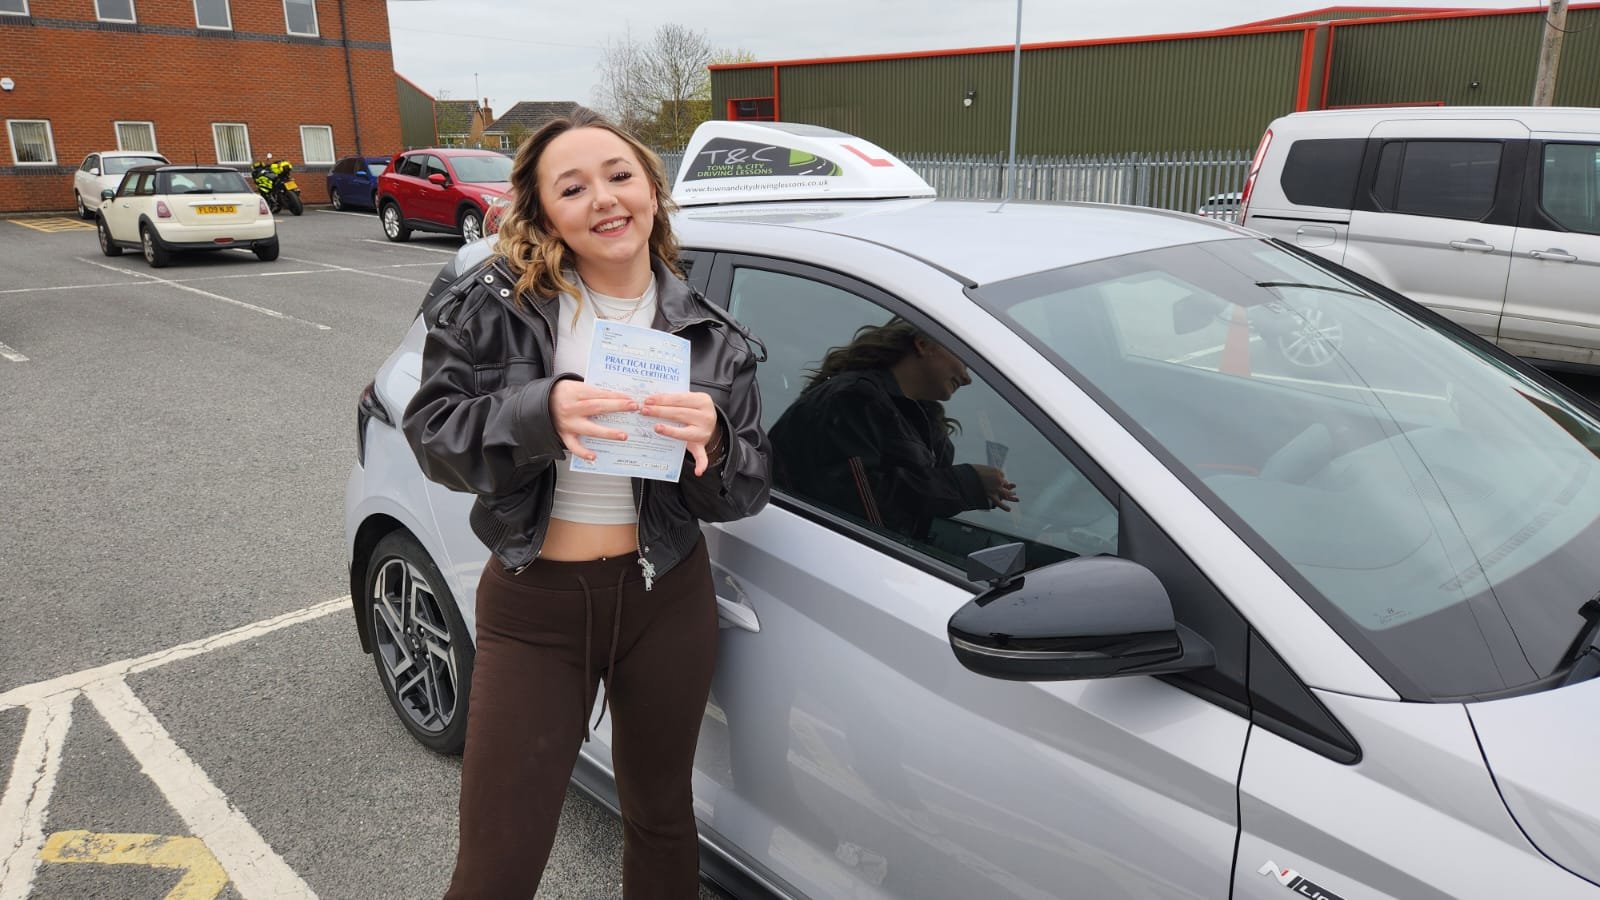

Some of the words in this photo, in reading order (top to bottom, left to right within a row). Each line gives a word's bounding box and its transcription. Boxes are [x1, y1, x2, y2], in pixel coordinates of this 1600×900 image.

[700, 146, 777, 165] T&C
[735, 168, 773, 176] LESSONS
[685, 179, 829, 193] www.townandcitydrivinglessons.co.uk
[605, 355, 647, 369] PRACTICAL
[649, 363, 680, 375] DRIVING
[605, 363, 621, 372] TEST
[622, 366, 640, 375] PASS
[640, 369, 680, 382] CERTIFICATE
